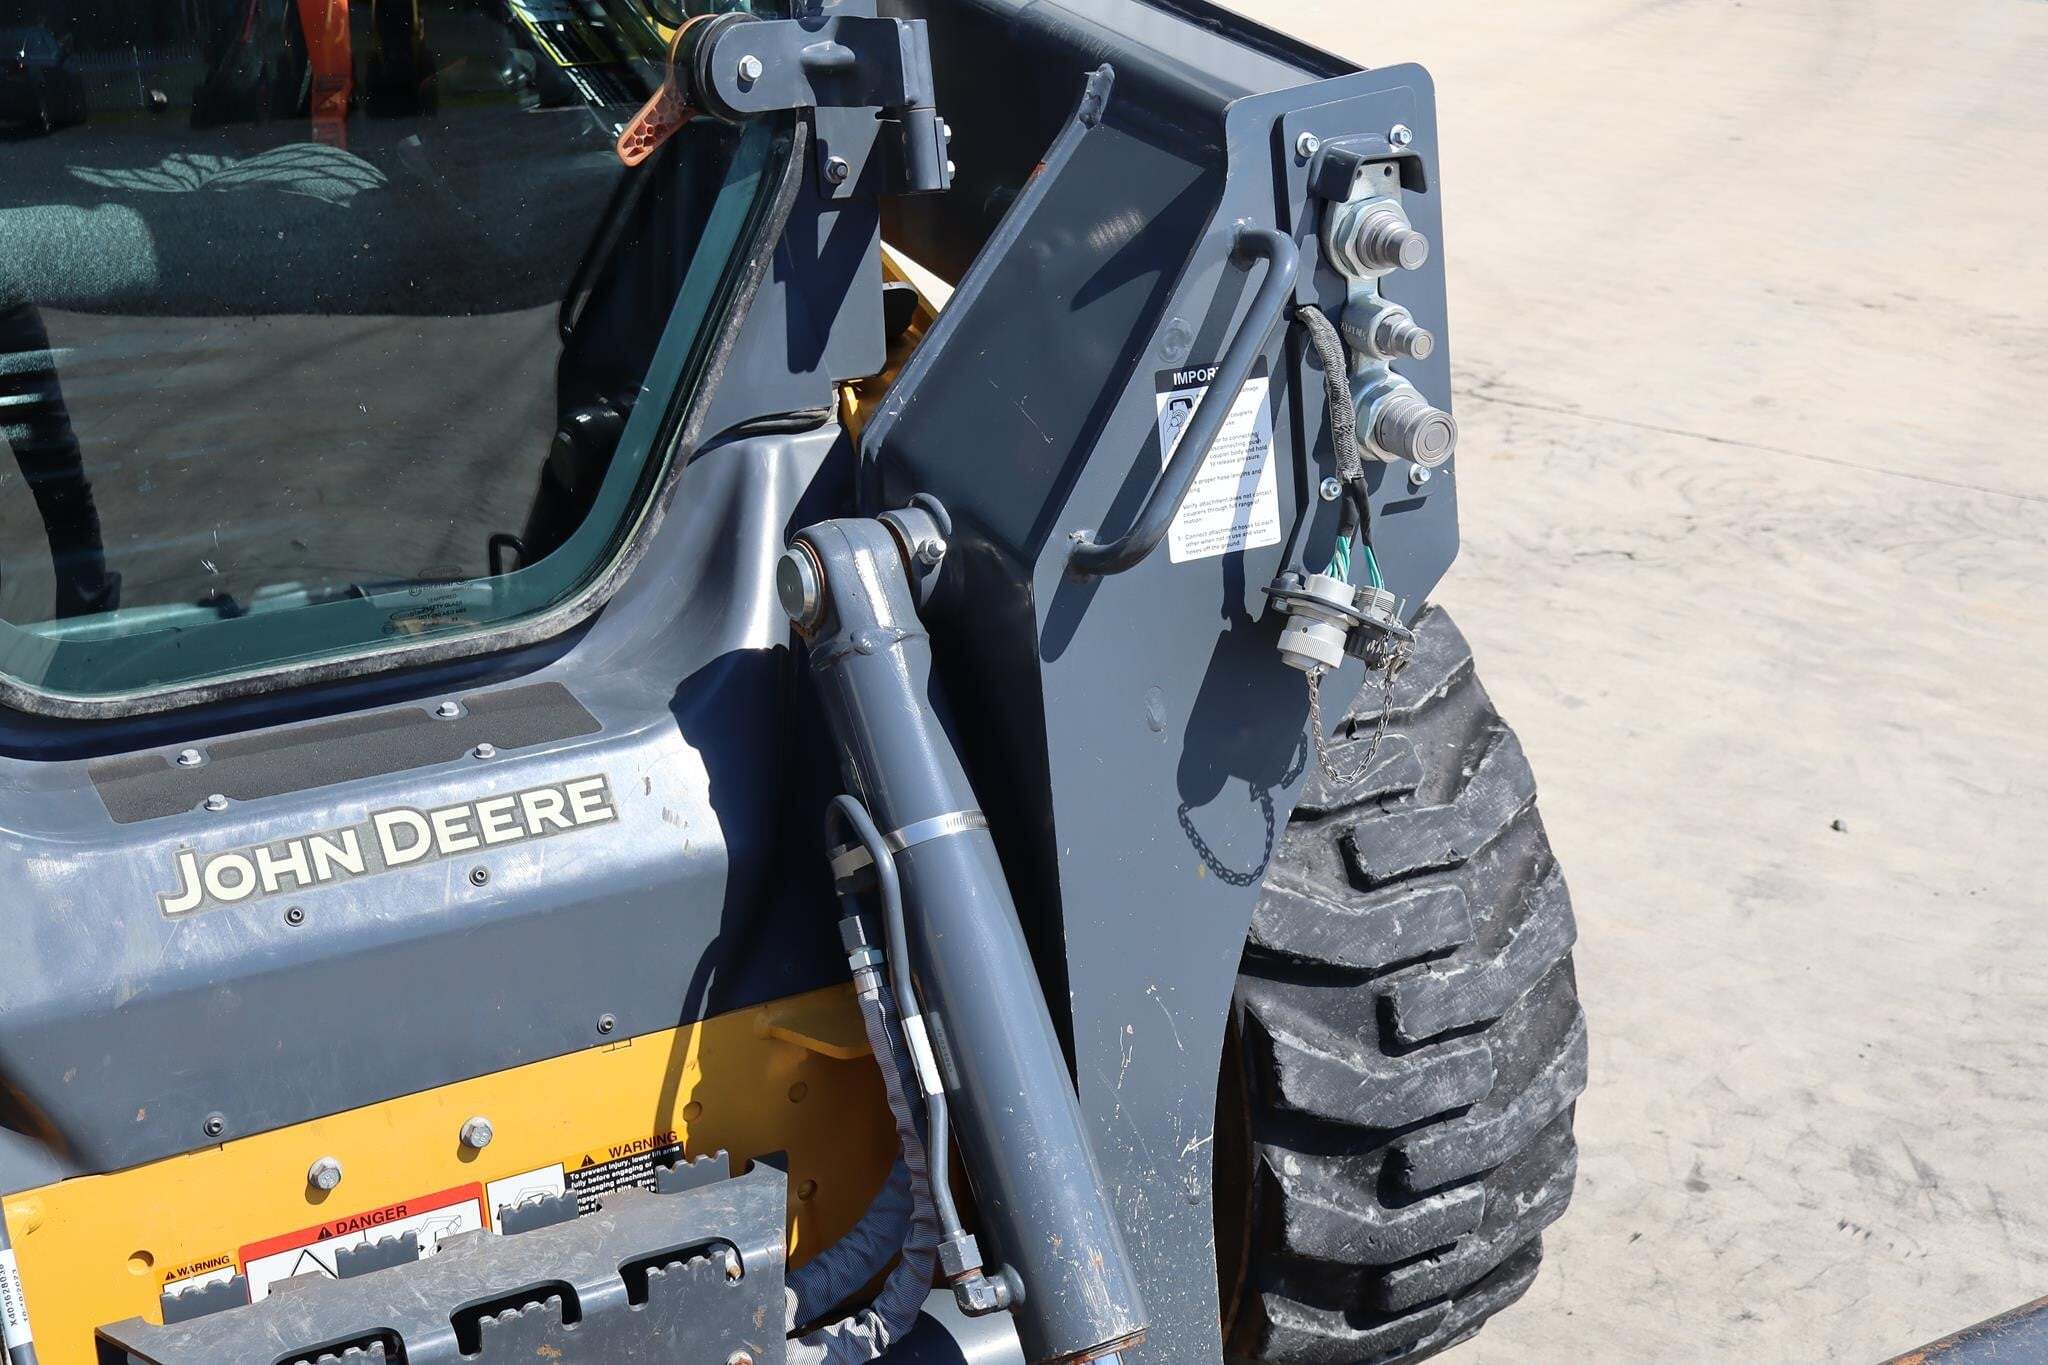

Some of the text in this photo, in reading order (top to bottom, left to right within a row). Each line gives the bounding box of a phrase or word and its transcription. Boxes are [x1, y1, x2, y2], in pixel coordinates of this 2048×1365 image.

[1173, 367, 1220, 386] IMPOR
[163, 776, 614, 915] JOHN DEERE
[608, 1130, 678, 1159] WARNING
[570, 1172, 580, 1181] To
[580, 1165, 608, 1180] prevent
[631, 1153, 651, 1165] lower
[570, 1161, 653, 1191] fully before engaging or
[615, 1169, 654, 1186] attachment
[577, 1188, 616, 1205] ngagement
[335, 1204, 408, 1235] DANGER
[176, 1254, 230, 1278] WARNING
